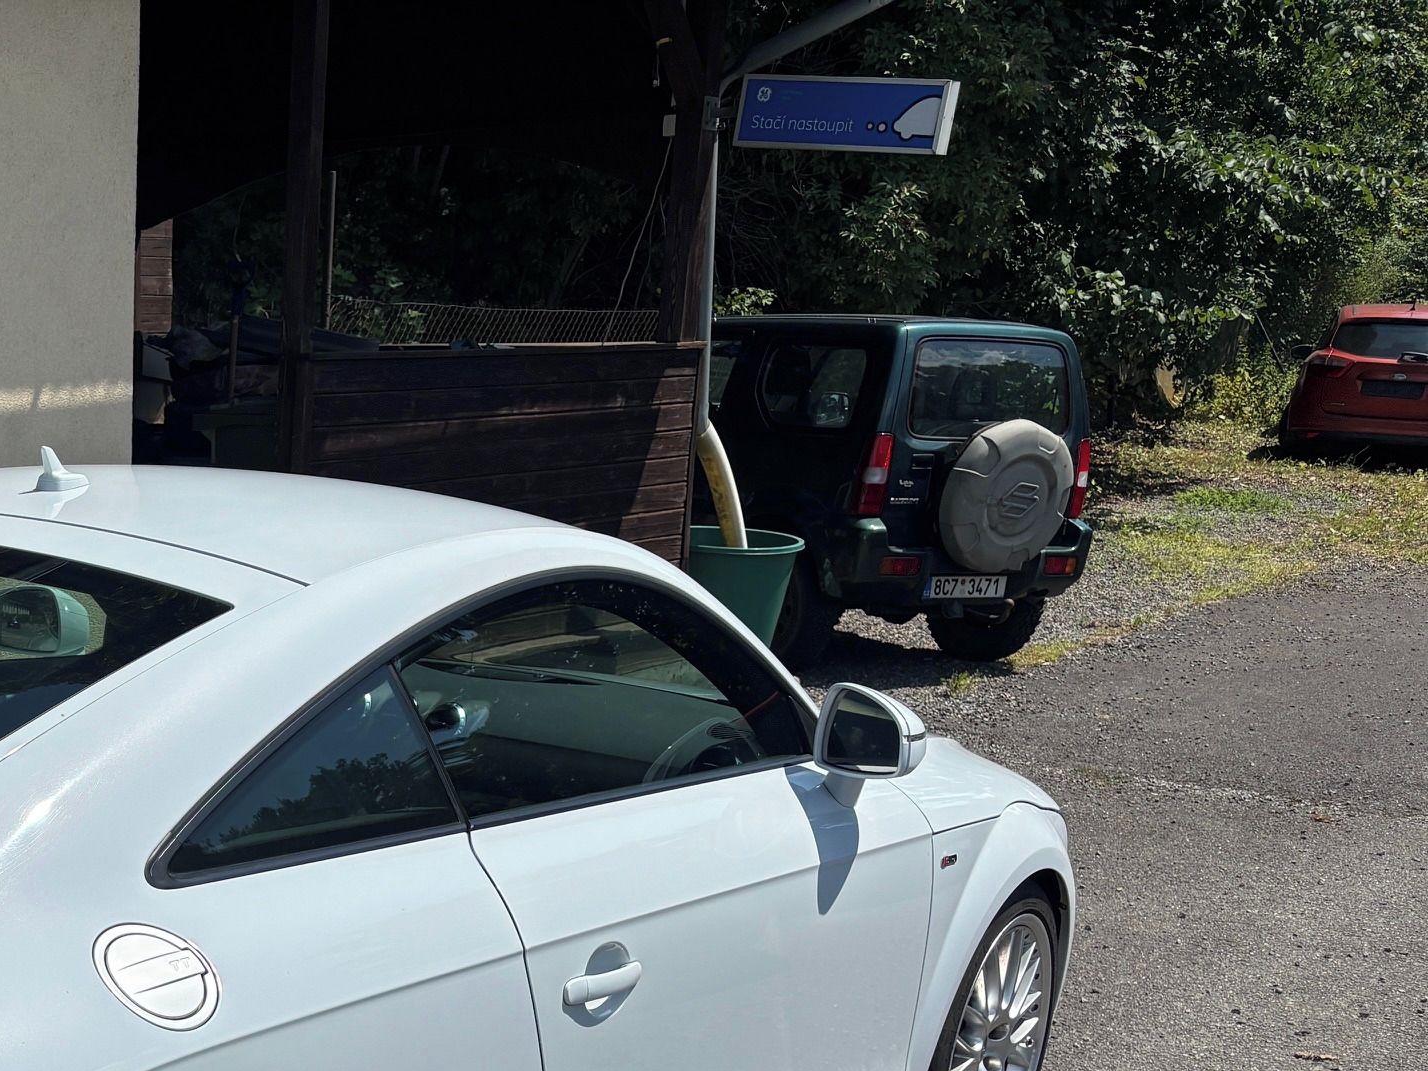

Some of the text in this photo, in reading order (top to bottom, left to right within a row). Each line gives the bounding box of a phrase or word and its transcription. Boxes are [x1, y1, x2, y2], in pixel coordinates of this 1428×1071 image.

[751, 114, 854, 134] Stačí nastoupit
[933, 578, 958, 596] 8C7
[967, 578, 1000, 596] 3471
[168, 956, 190, 972] TT
